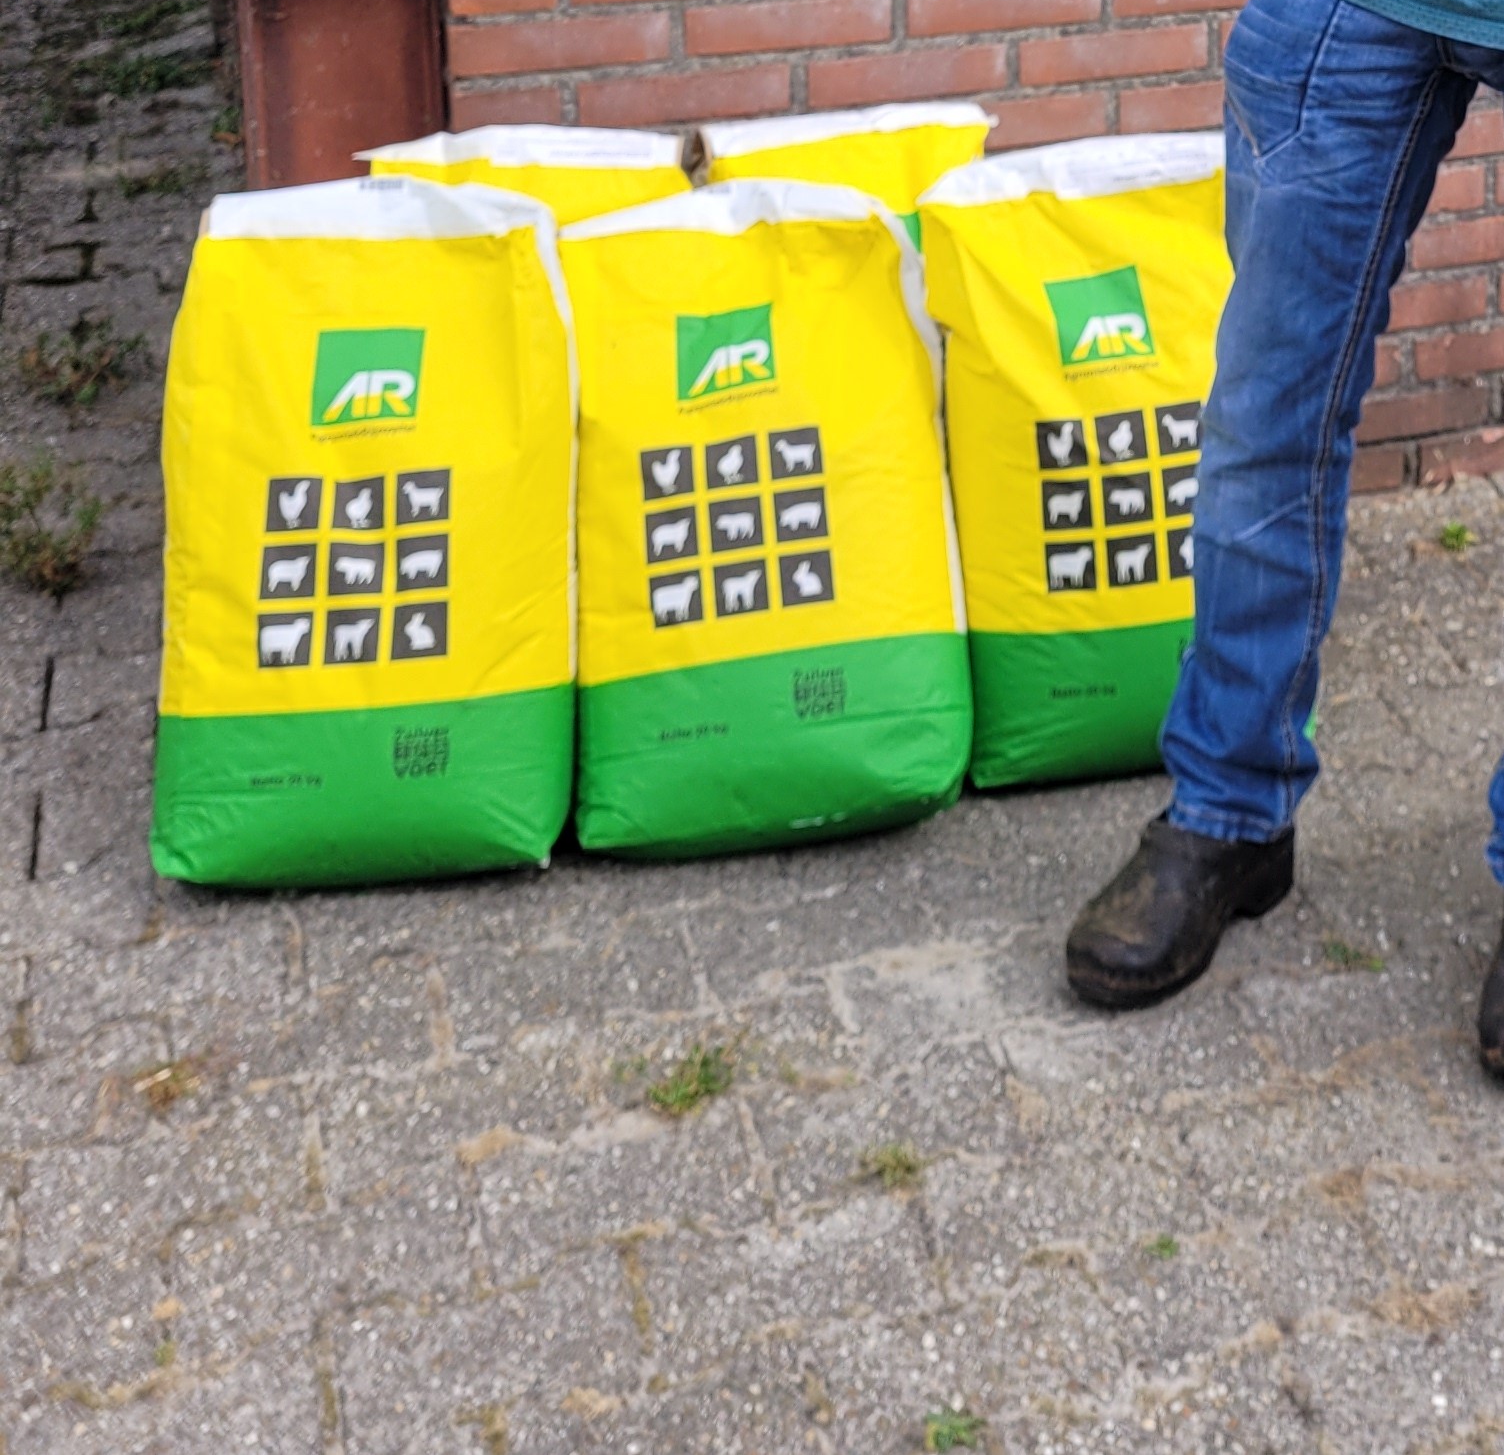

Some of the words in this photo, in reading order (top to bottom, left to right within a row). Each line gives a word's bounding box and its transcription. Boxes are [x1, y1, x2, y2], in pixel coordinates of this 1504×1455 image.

[1070, 312, 1152, 361] AR
[687, 338, 771, 397] AR
[322, 369, 416, 423] AR
